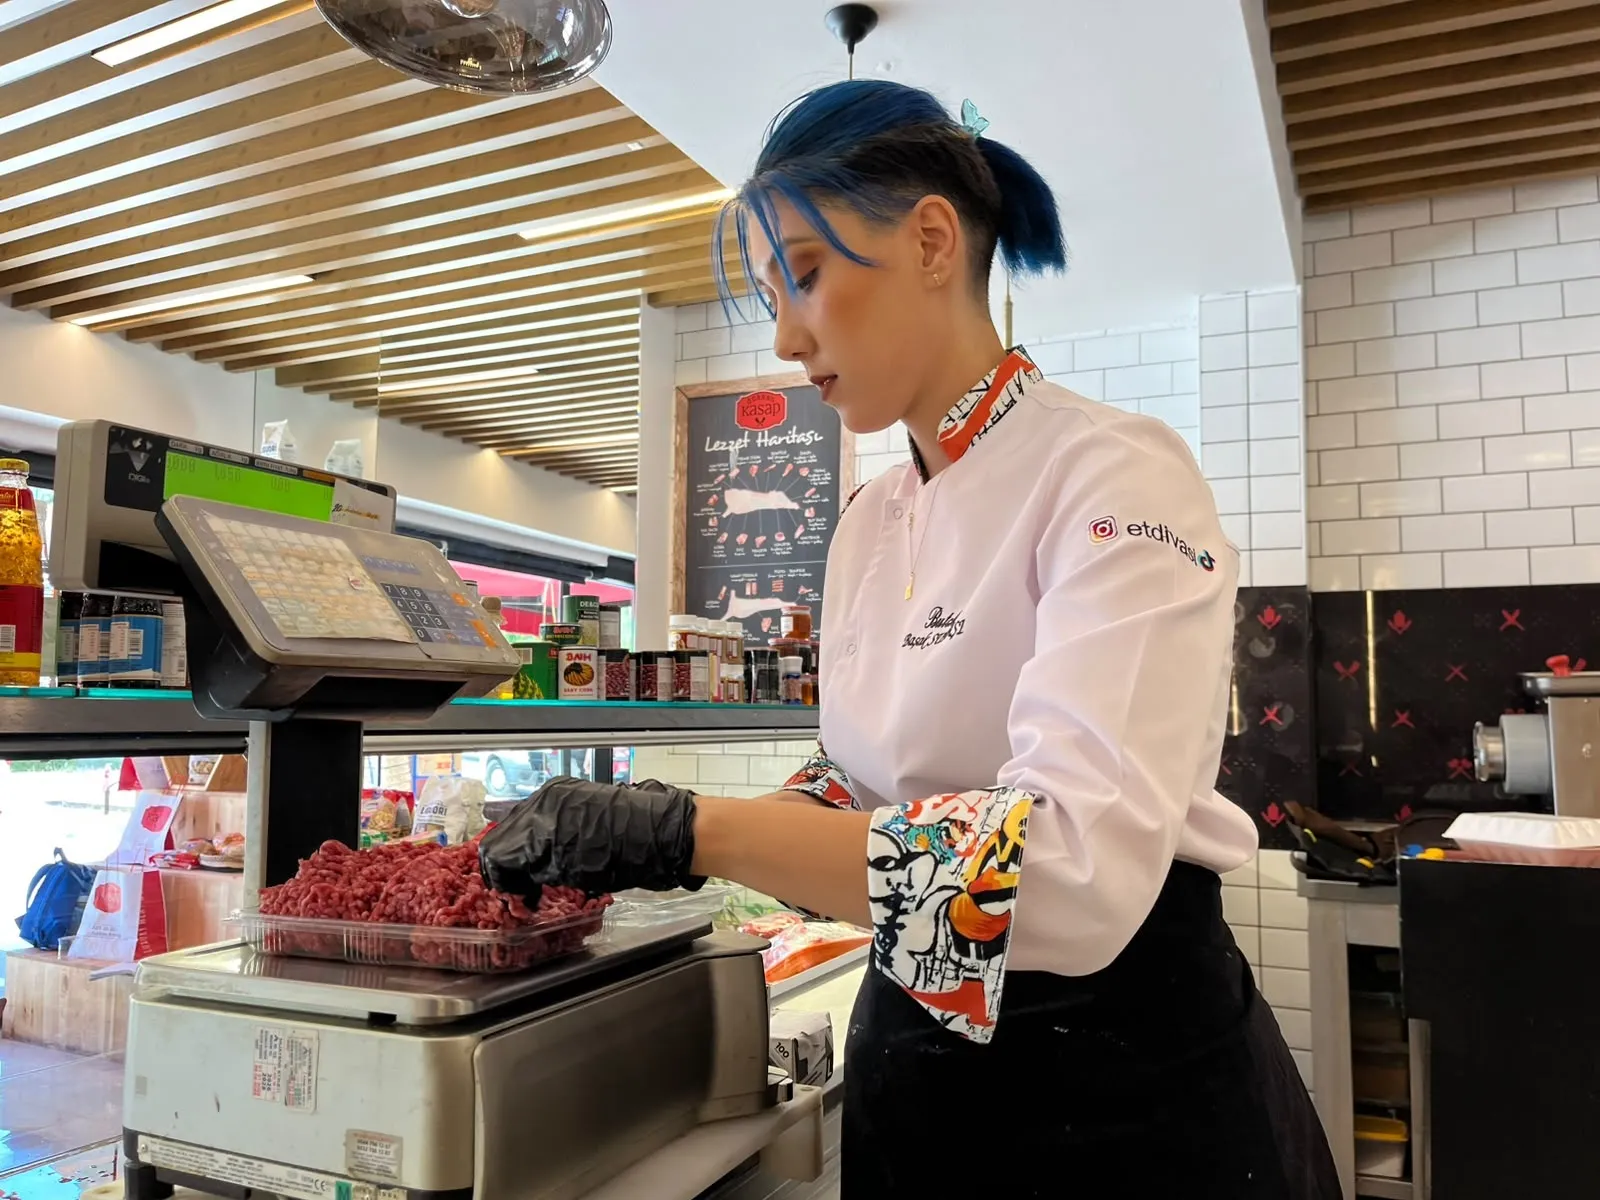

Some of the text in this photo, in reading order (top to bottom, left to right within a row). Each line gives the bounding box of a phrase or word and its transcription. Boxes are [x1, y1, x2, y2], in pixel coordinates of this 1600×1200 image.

[705, 425, 823, 452] Lezzet Haritası
[775, 1041, 790, 1059] 100
